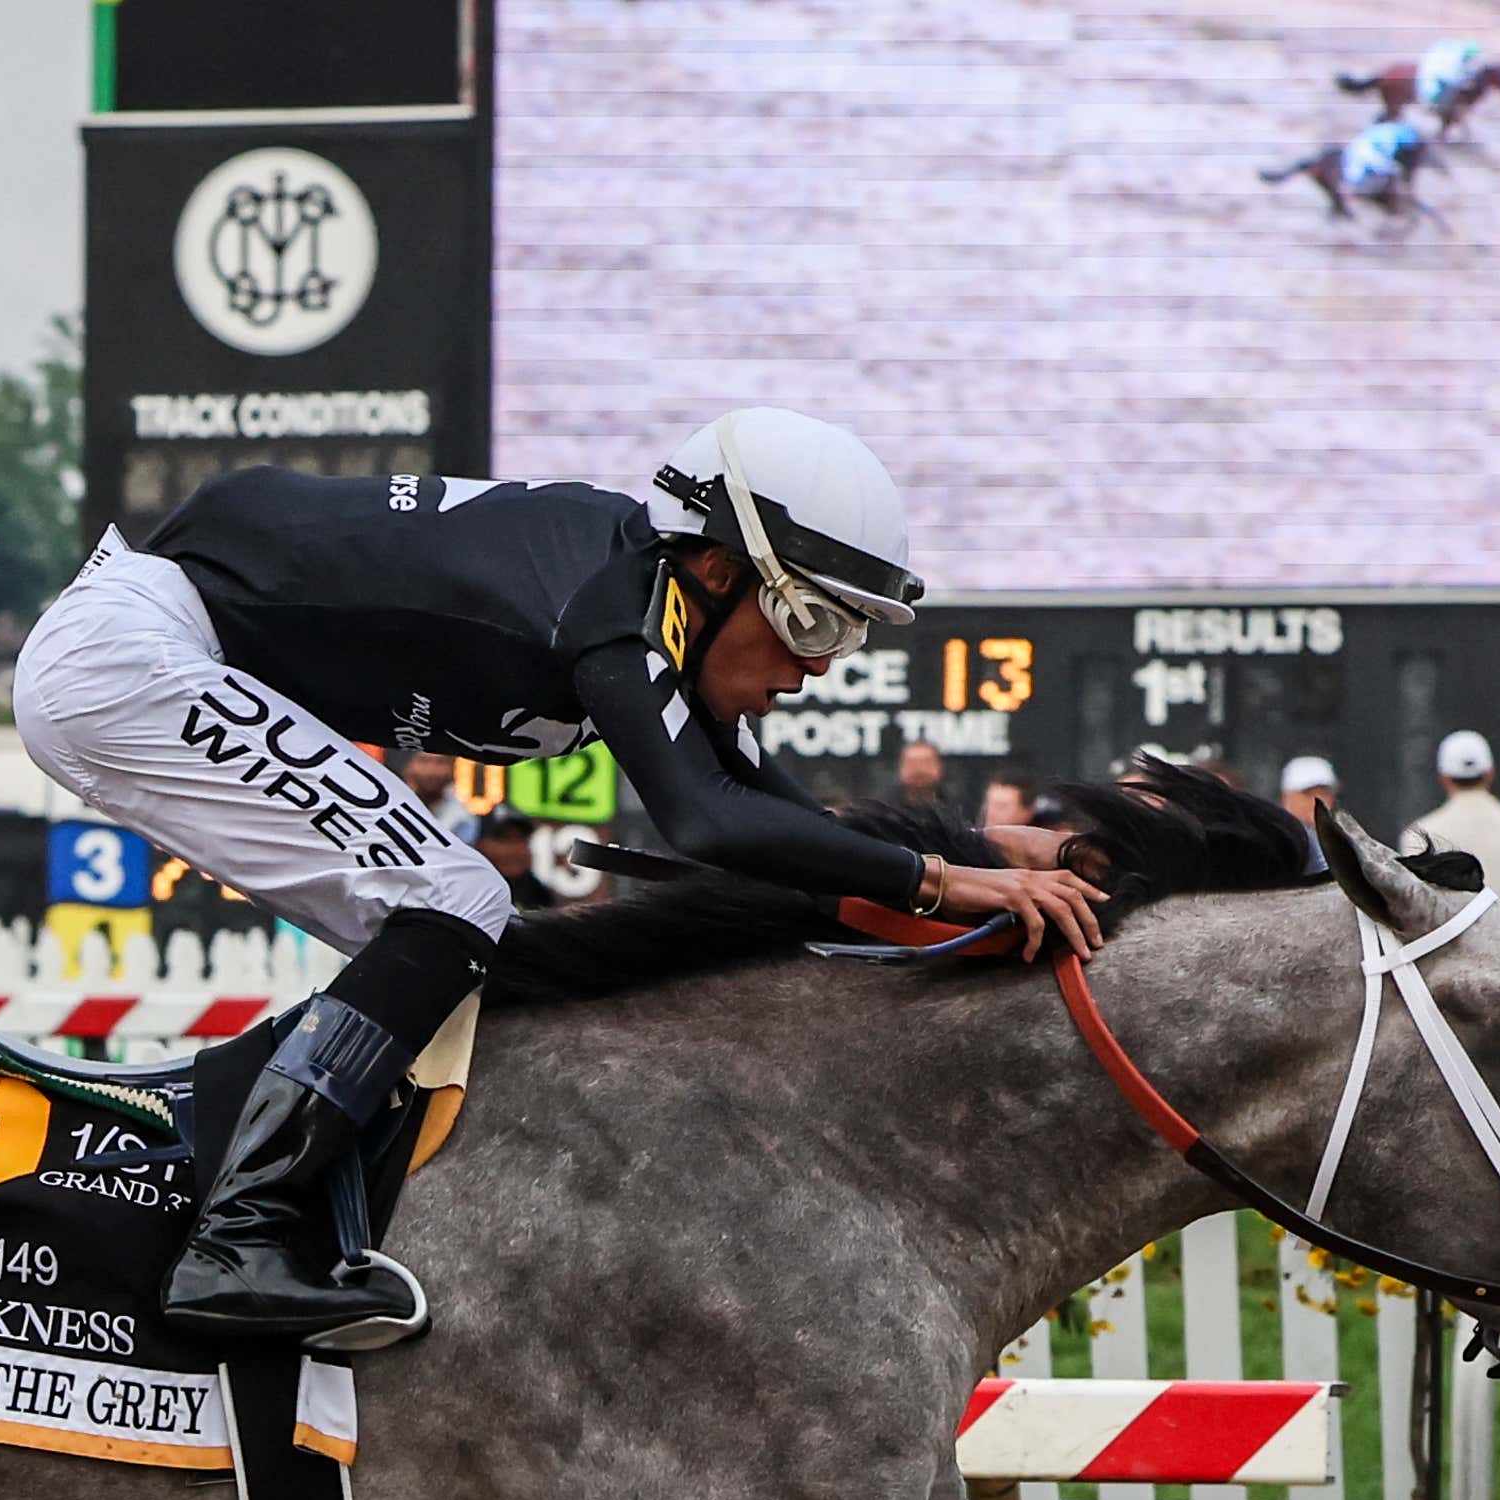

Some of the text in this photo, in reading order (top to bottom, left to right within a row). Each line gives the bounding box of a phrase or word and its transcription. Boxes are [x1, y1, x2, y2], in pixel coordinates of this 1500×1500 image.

[131, 389, 430, 439] TRACK CONDITIONS
[1133, 608, 1344, 655] RESULTS
[944, 637, 1034, 712] 13
[1132, 658, 1206, 726] 1st
[761, 707, 1011, 757] POST TIME
[539, 751, 595, 806] 12
[71, 828, 126, 902] 3
[38, 1170, 160, 1207] GRAND
[86, 1377, 211, 1434] GREY
